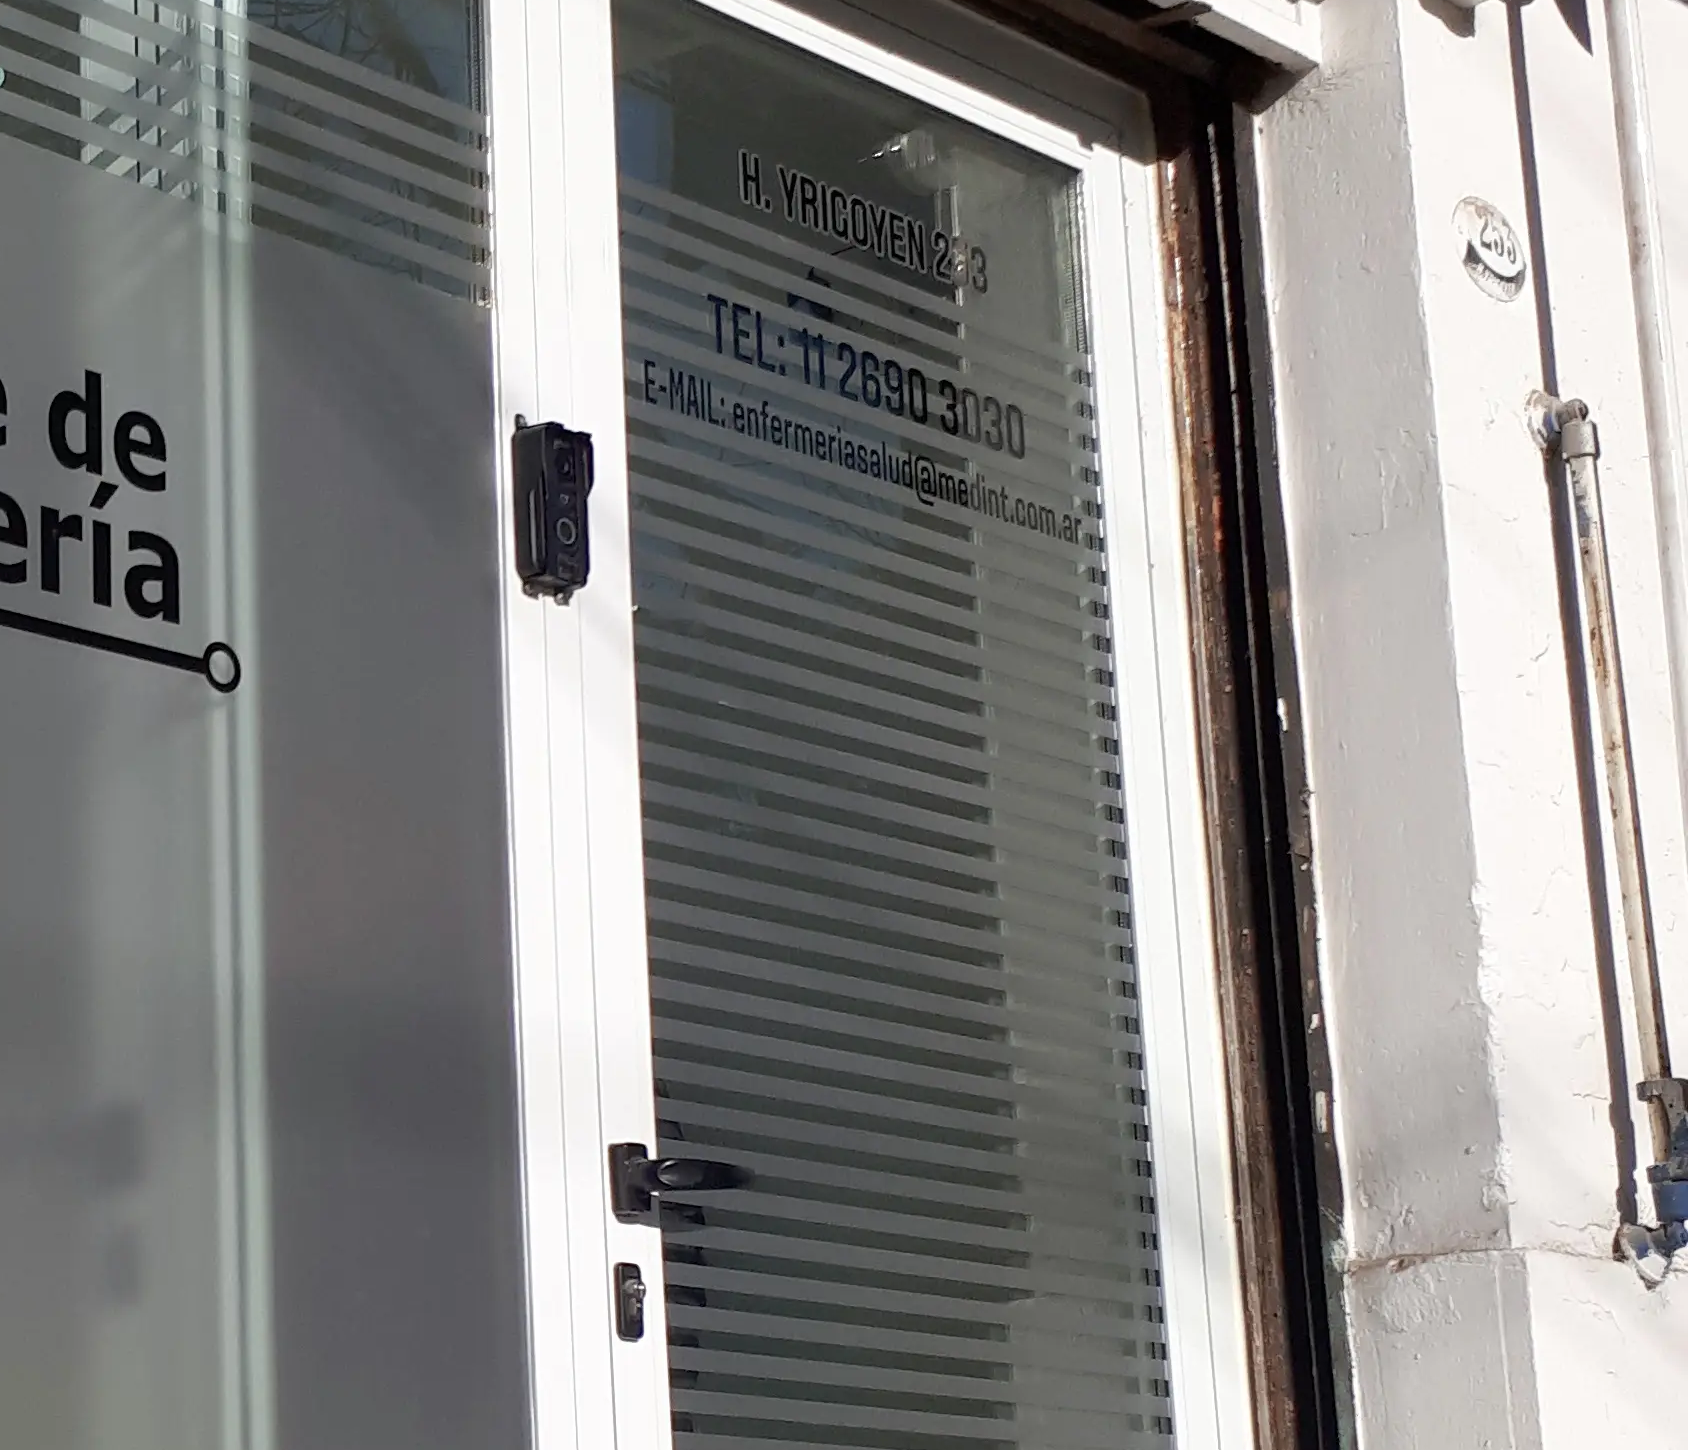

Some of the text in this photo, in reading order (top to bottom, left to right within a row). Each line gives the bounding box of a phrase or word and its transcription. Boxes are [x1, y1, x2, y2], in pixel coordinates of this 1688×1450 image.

[740, 151, 987, 293] H. YRIGOYEN 23
[48, 370, 167, 491] de
[707, 293, 1025, 459] TEL: 11 2690 3030
